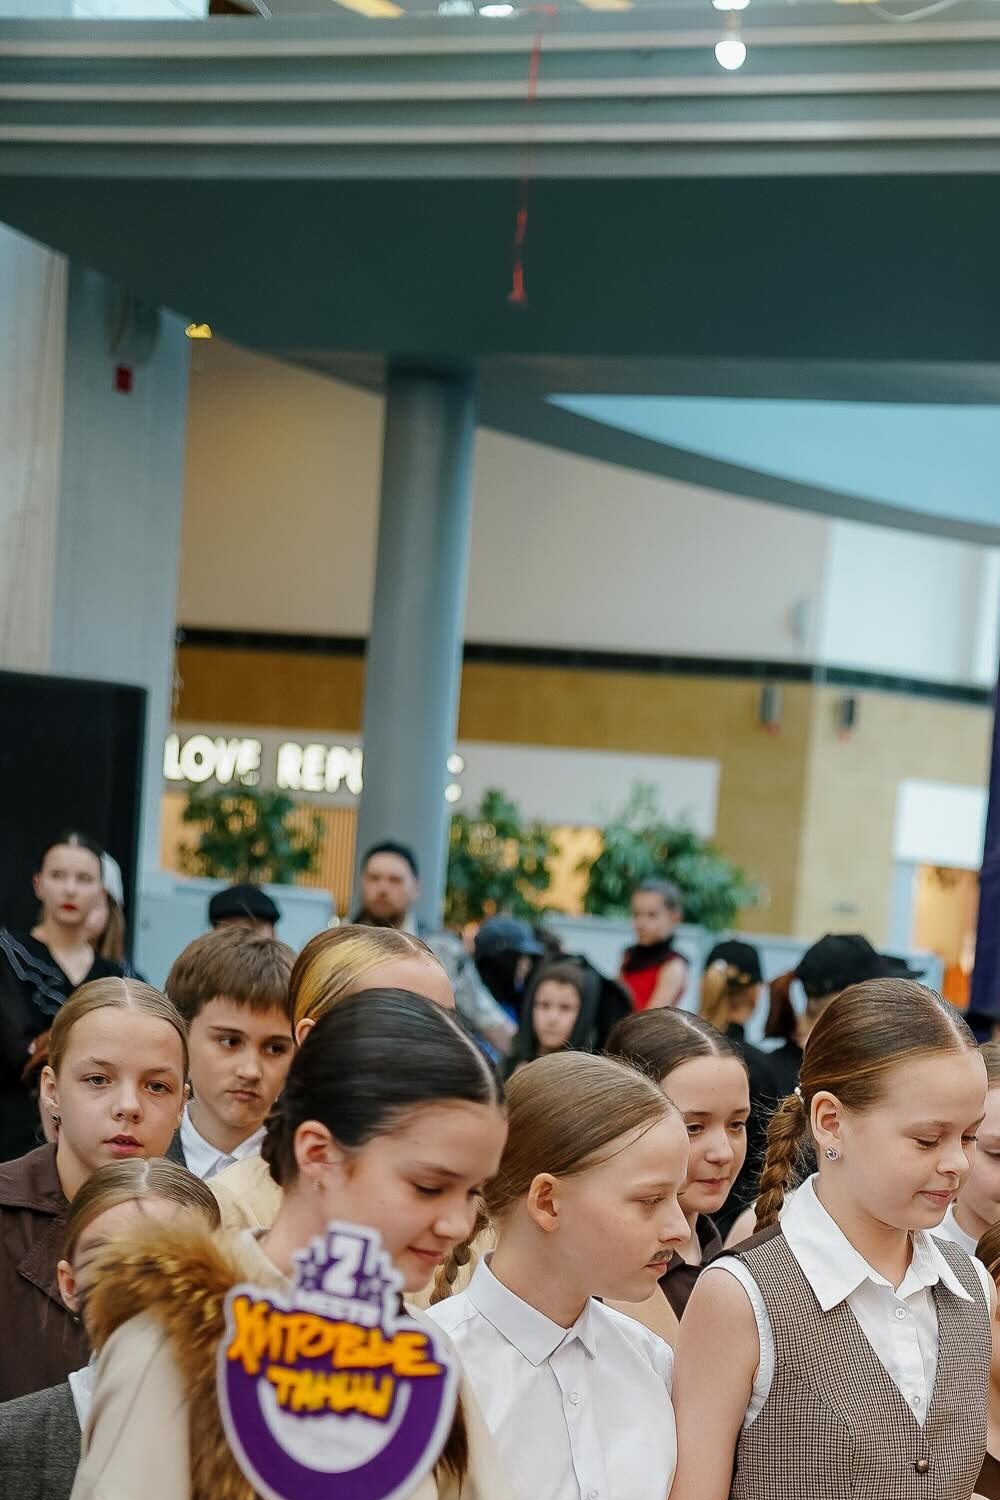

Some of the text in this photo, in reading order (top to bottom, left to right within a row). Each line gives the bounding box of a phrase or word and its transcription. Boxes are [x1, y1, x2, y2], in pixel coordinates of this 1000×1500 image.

[163, 733, 261, 786] LOVE
[322, 1231, 367, 1298] 2
[226, 1294, 444, 1377] ХИТОВЫЕ
[265, 1364, 395, 1419] ТАНЦЫ
